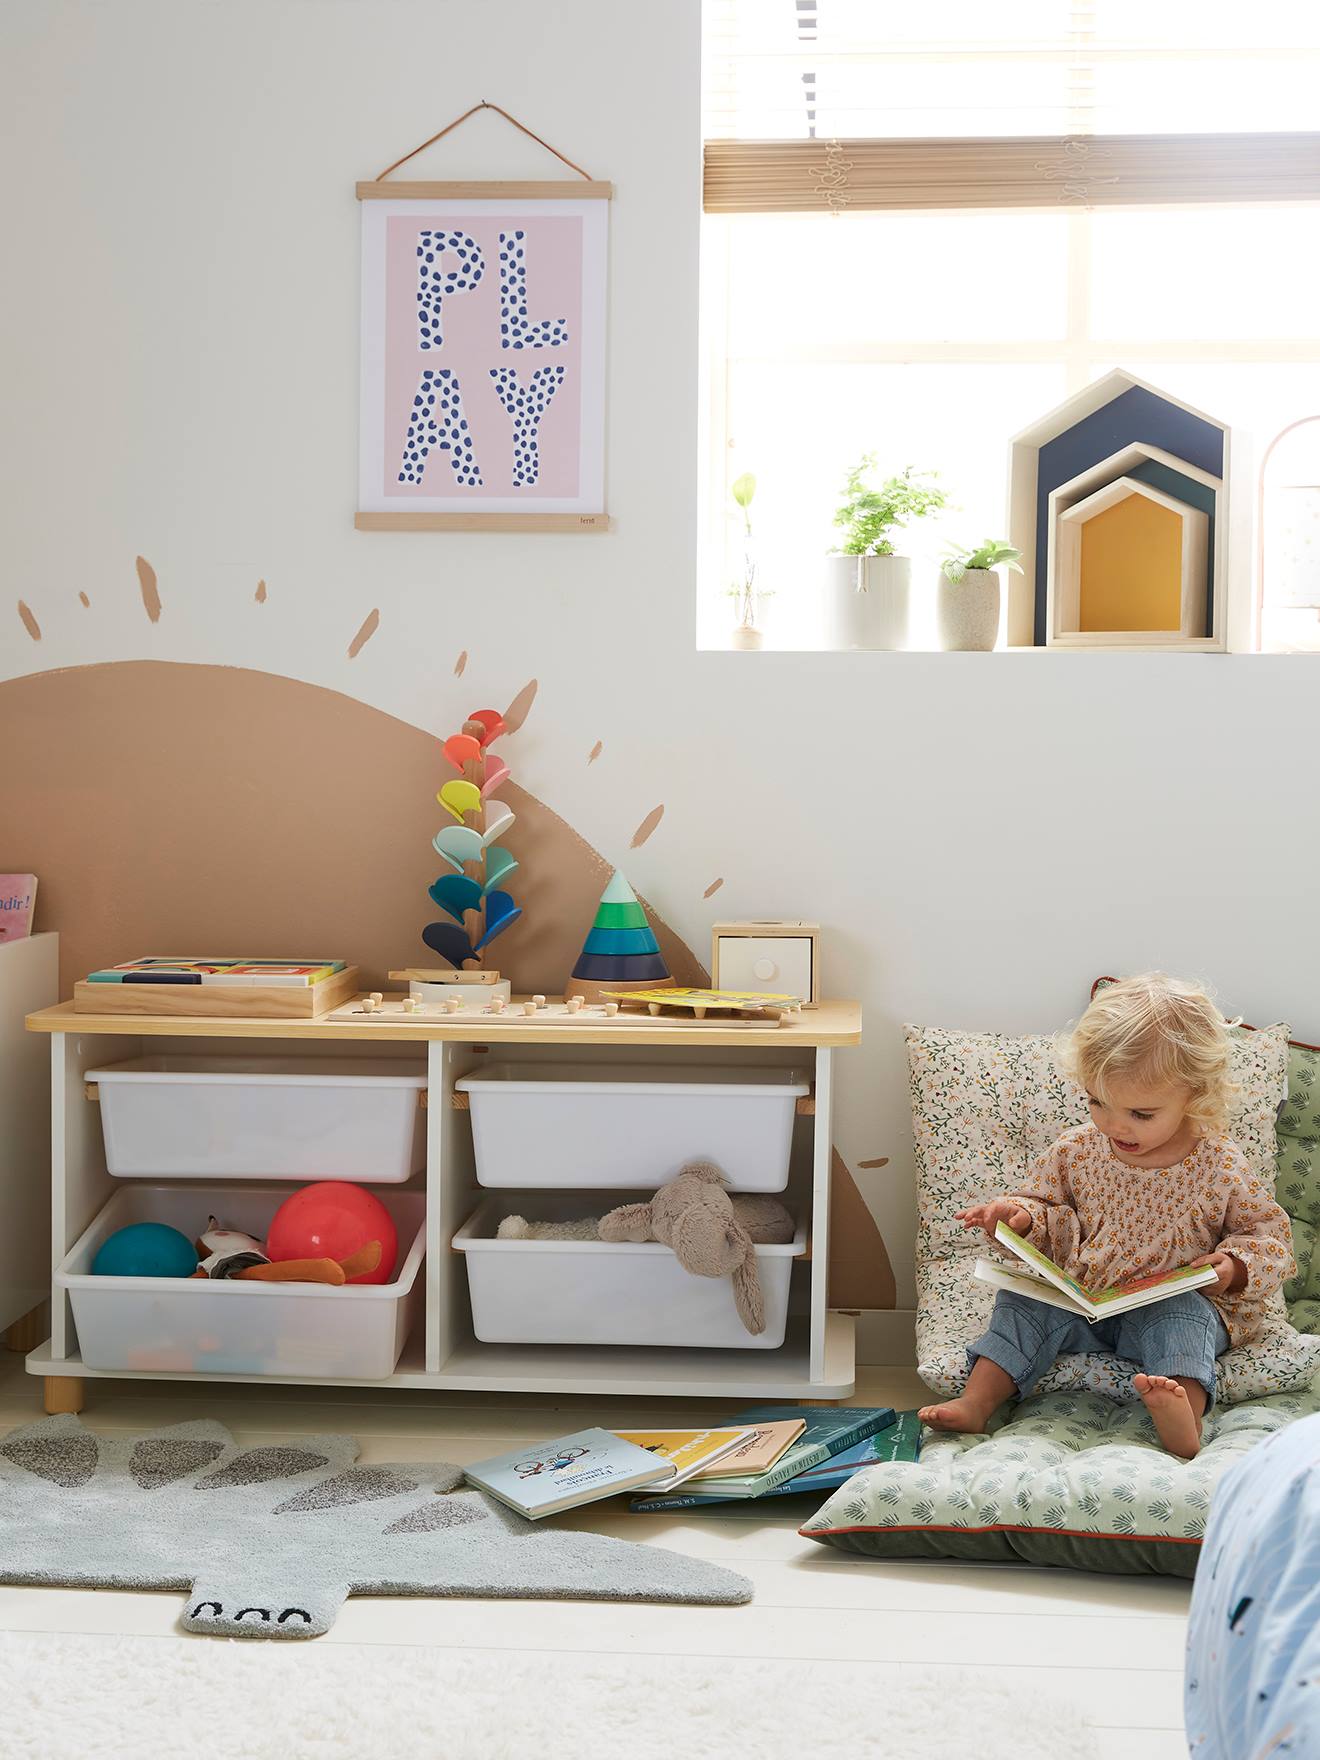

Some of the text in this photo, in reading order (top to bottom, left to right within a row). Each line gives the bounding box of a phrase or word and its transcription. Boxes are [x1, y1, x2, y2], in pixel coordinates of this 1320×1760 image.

[417, 229, 569, 352] PL
[398, 366, 567, 487] AY
[766, 1467, 790, 1487] FAUSTO
